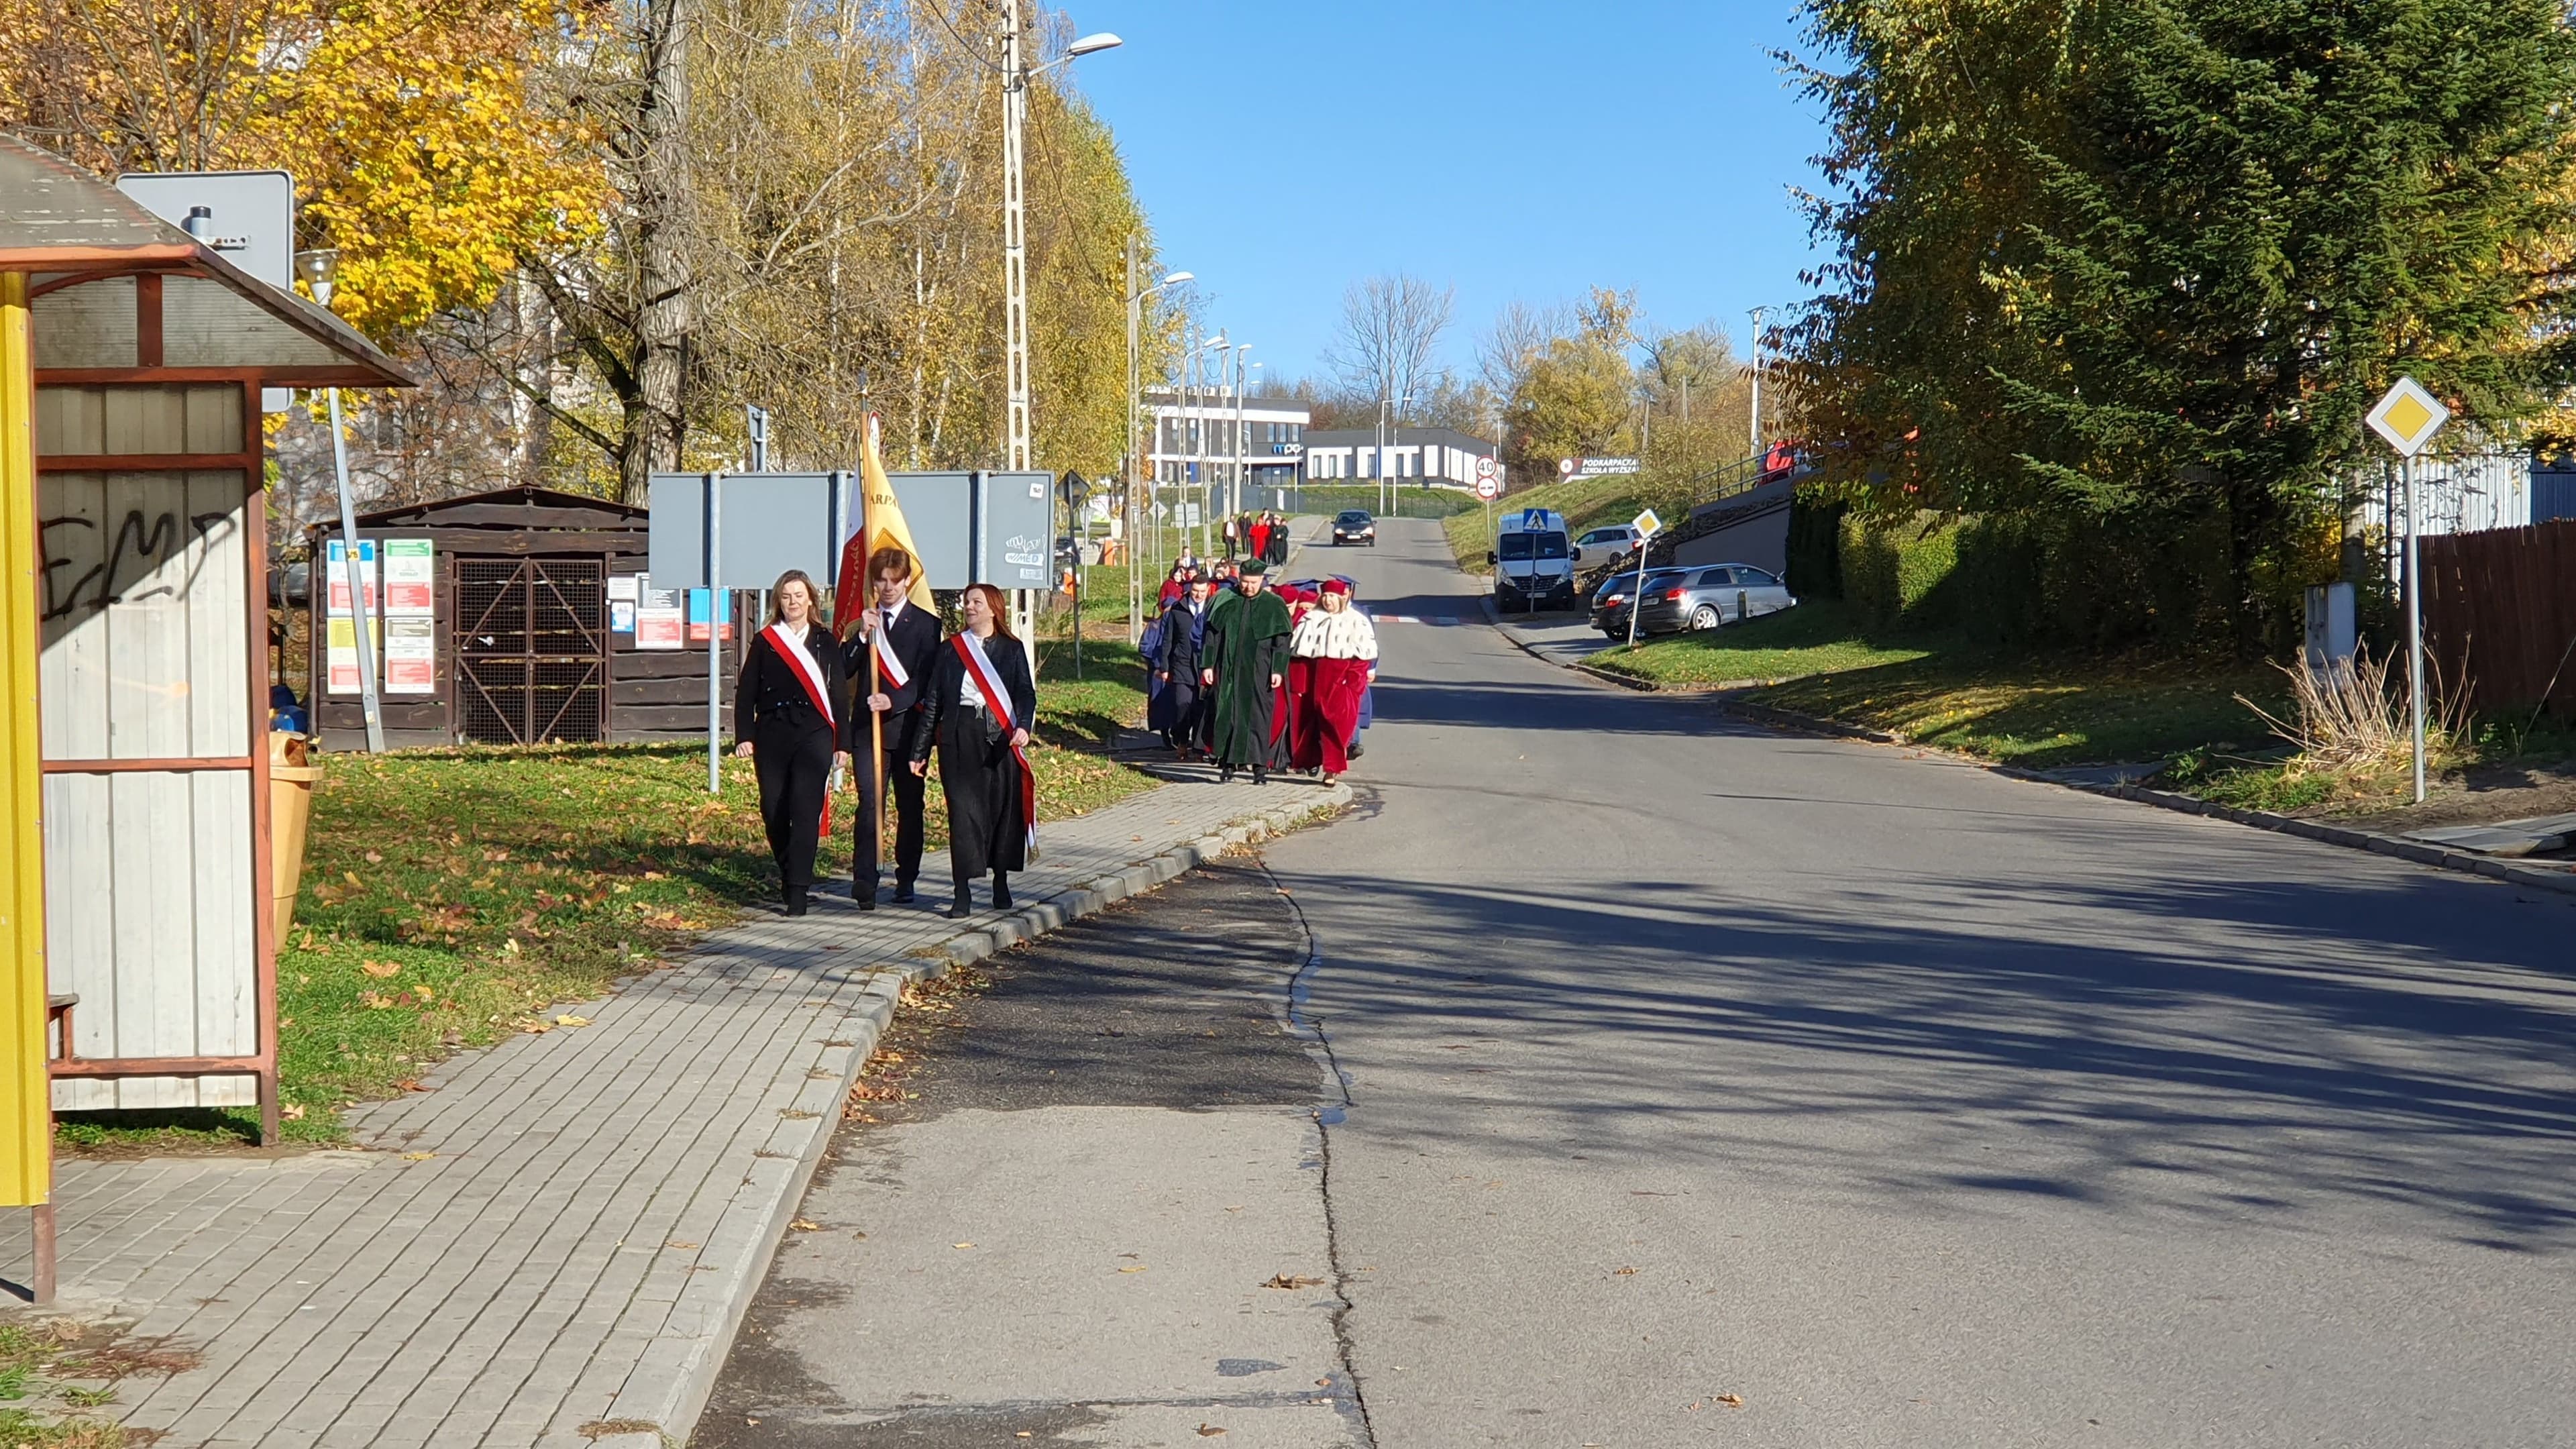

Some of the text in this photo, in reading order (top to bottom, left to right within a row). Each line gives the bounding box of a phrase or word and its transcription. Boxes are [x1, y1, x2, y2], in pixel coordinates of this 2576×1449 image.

[1479, 462, 1494, 472] 40
[1582, 458, 1637, 467] PODKARPACKA
[869, 494, 897, 507] ARPA
